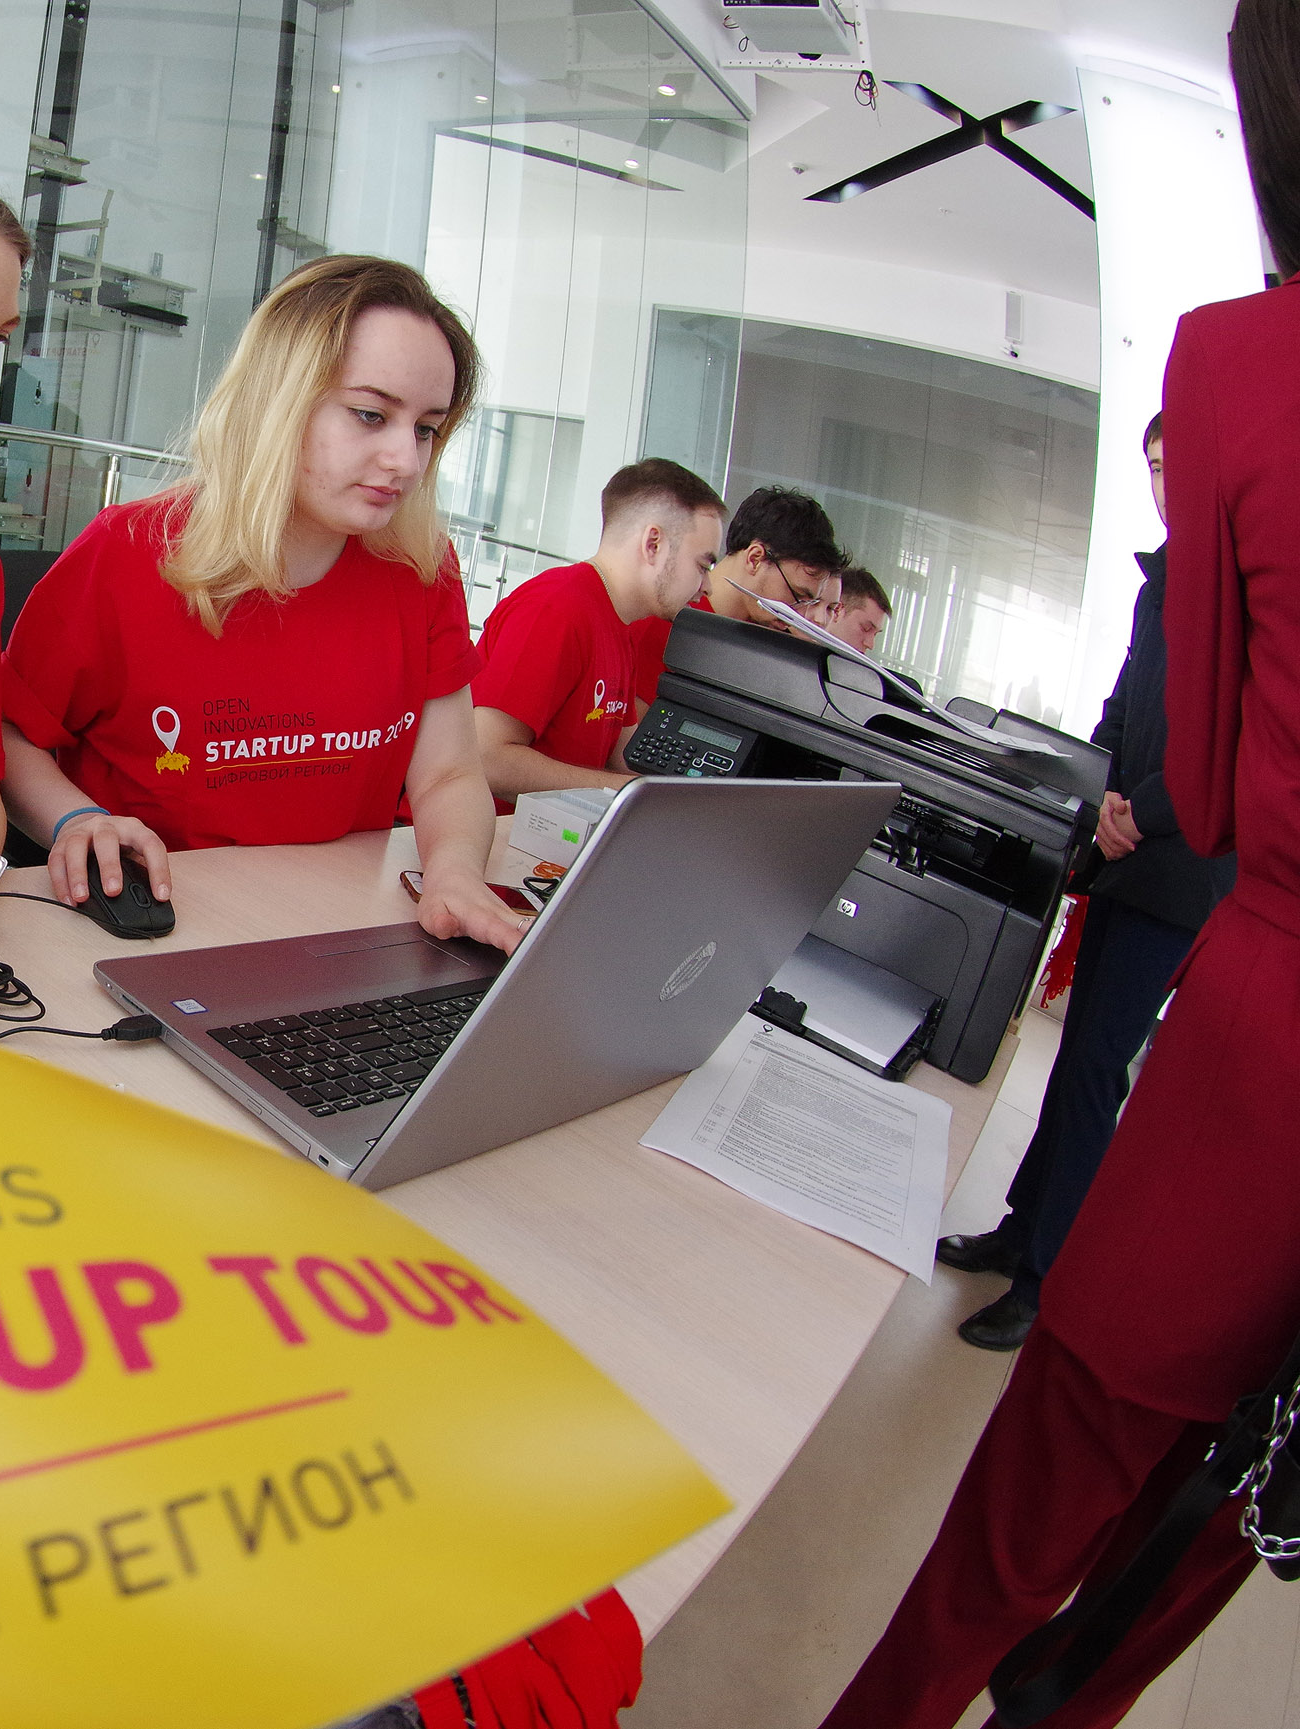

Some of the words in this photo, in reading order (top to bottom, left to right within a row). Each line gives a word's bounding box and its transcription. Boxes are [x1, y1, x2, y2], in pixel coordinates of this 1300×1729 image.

[203, 698, 250, 716] OPEN
[204, 712, 316, 735] INNOVATIONS
[205, 734, 315, 763] STARTUP
[321, 729, 382, 752] TOUR
[206, 766, 290, 790] ЦИФРОВОЙ
[294, 763, 352, 778] РЕГИОН
[206, 1255, 524, 1348] TOUR
[25, 1440, 417, 1620] РЕГИОН
